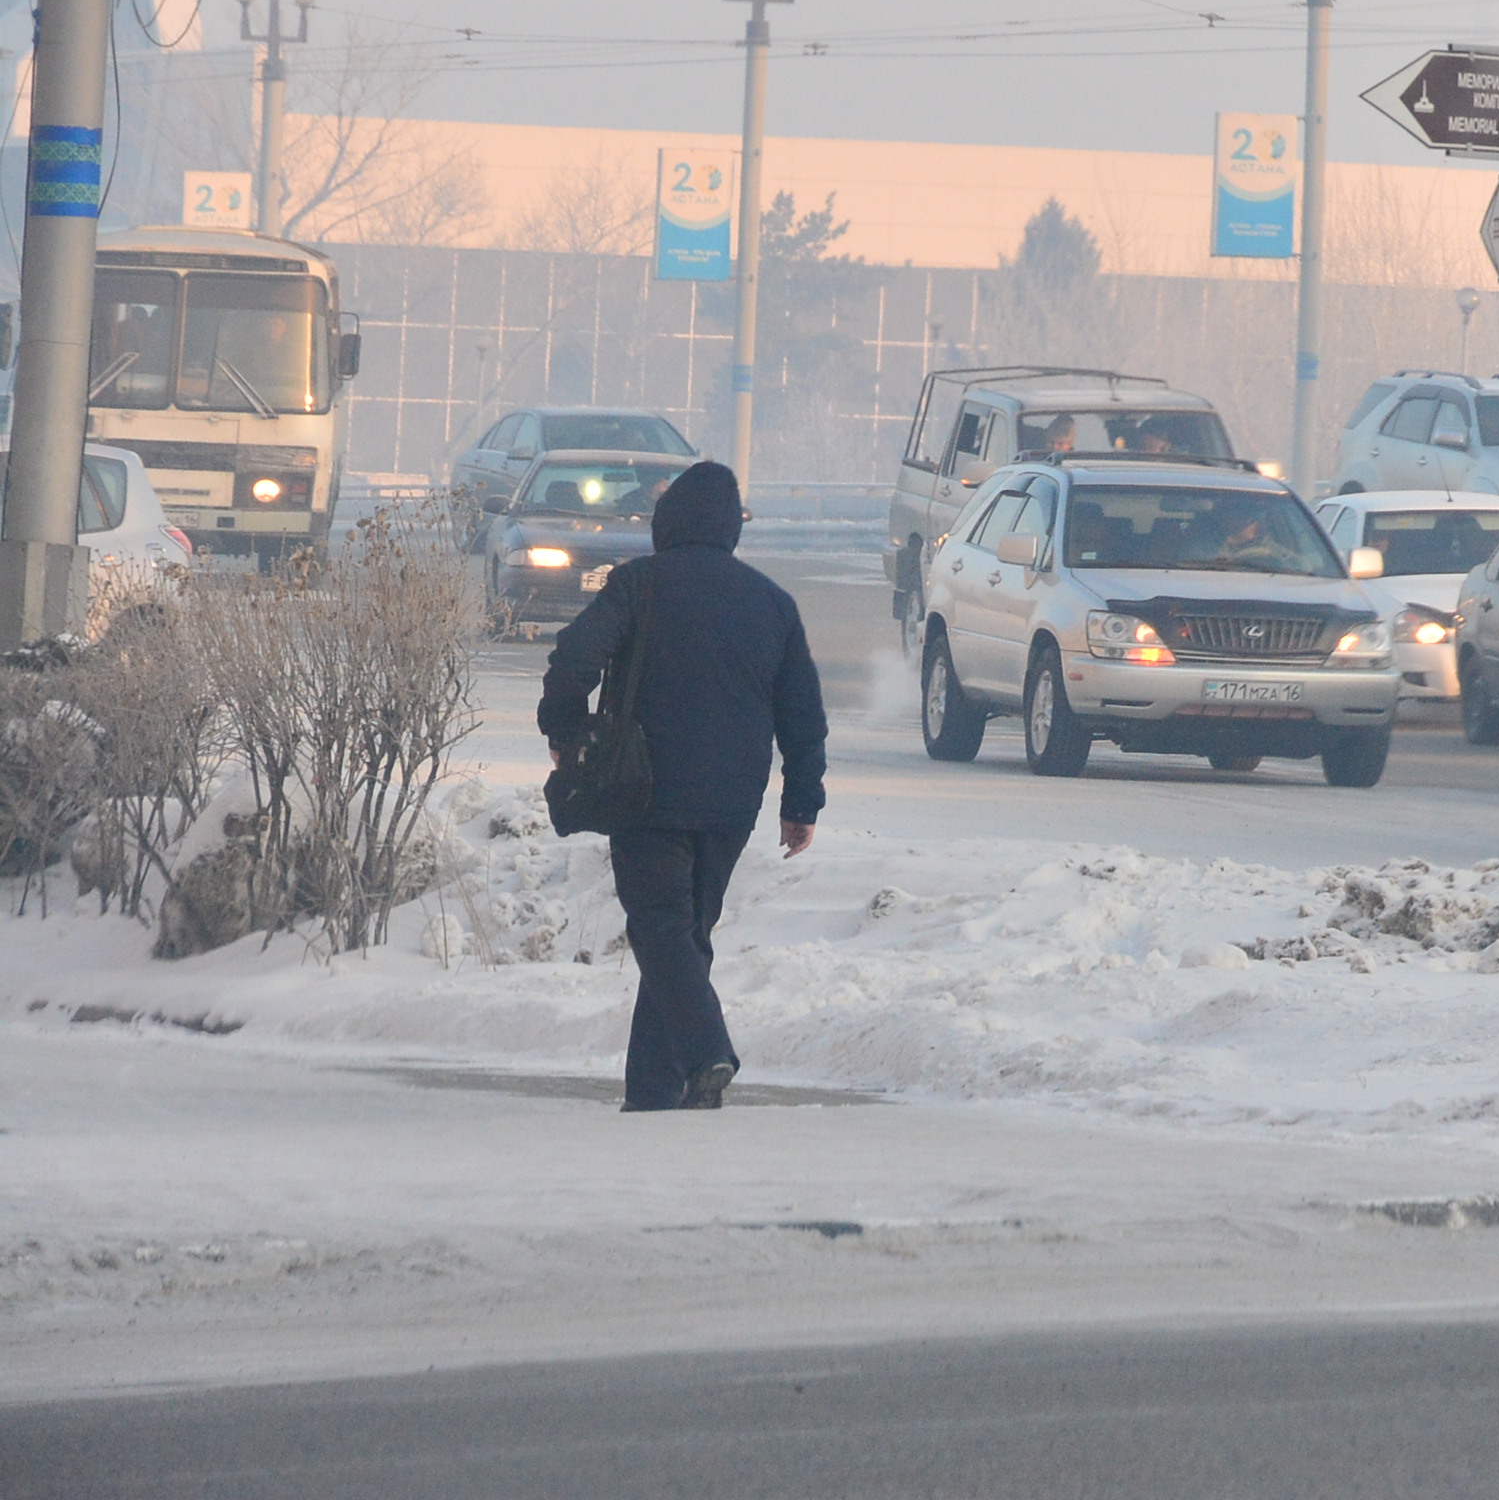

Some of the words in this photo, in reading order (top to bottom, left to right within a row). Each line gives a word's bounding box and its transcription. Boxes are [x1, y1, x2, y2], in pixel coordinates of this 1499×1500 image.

[1449, 115, 1499, 136] MEMORIAL
[1220, 683, 1278, 700] 171MZA
[1283, 685, 1301, 701] 16
